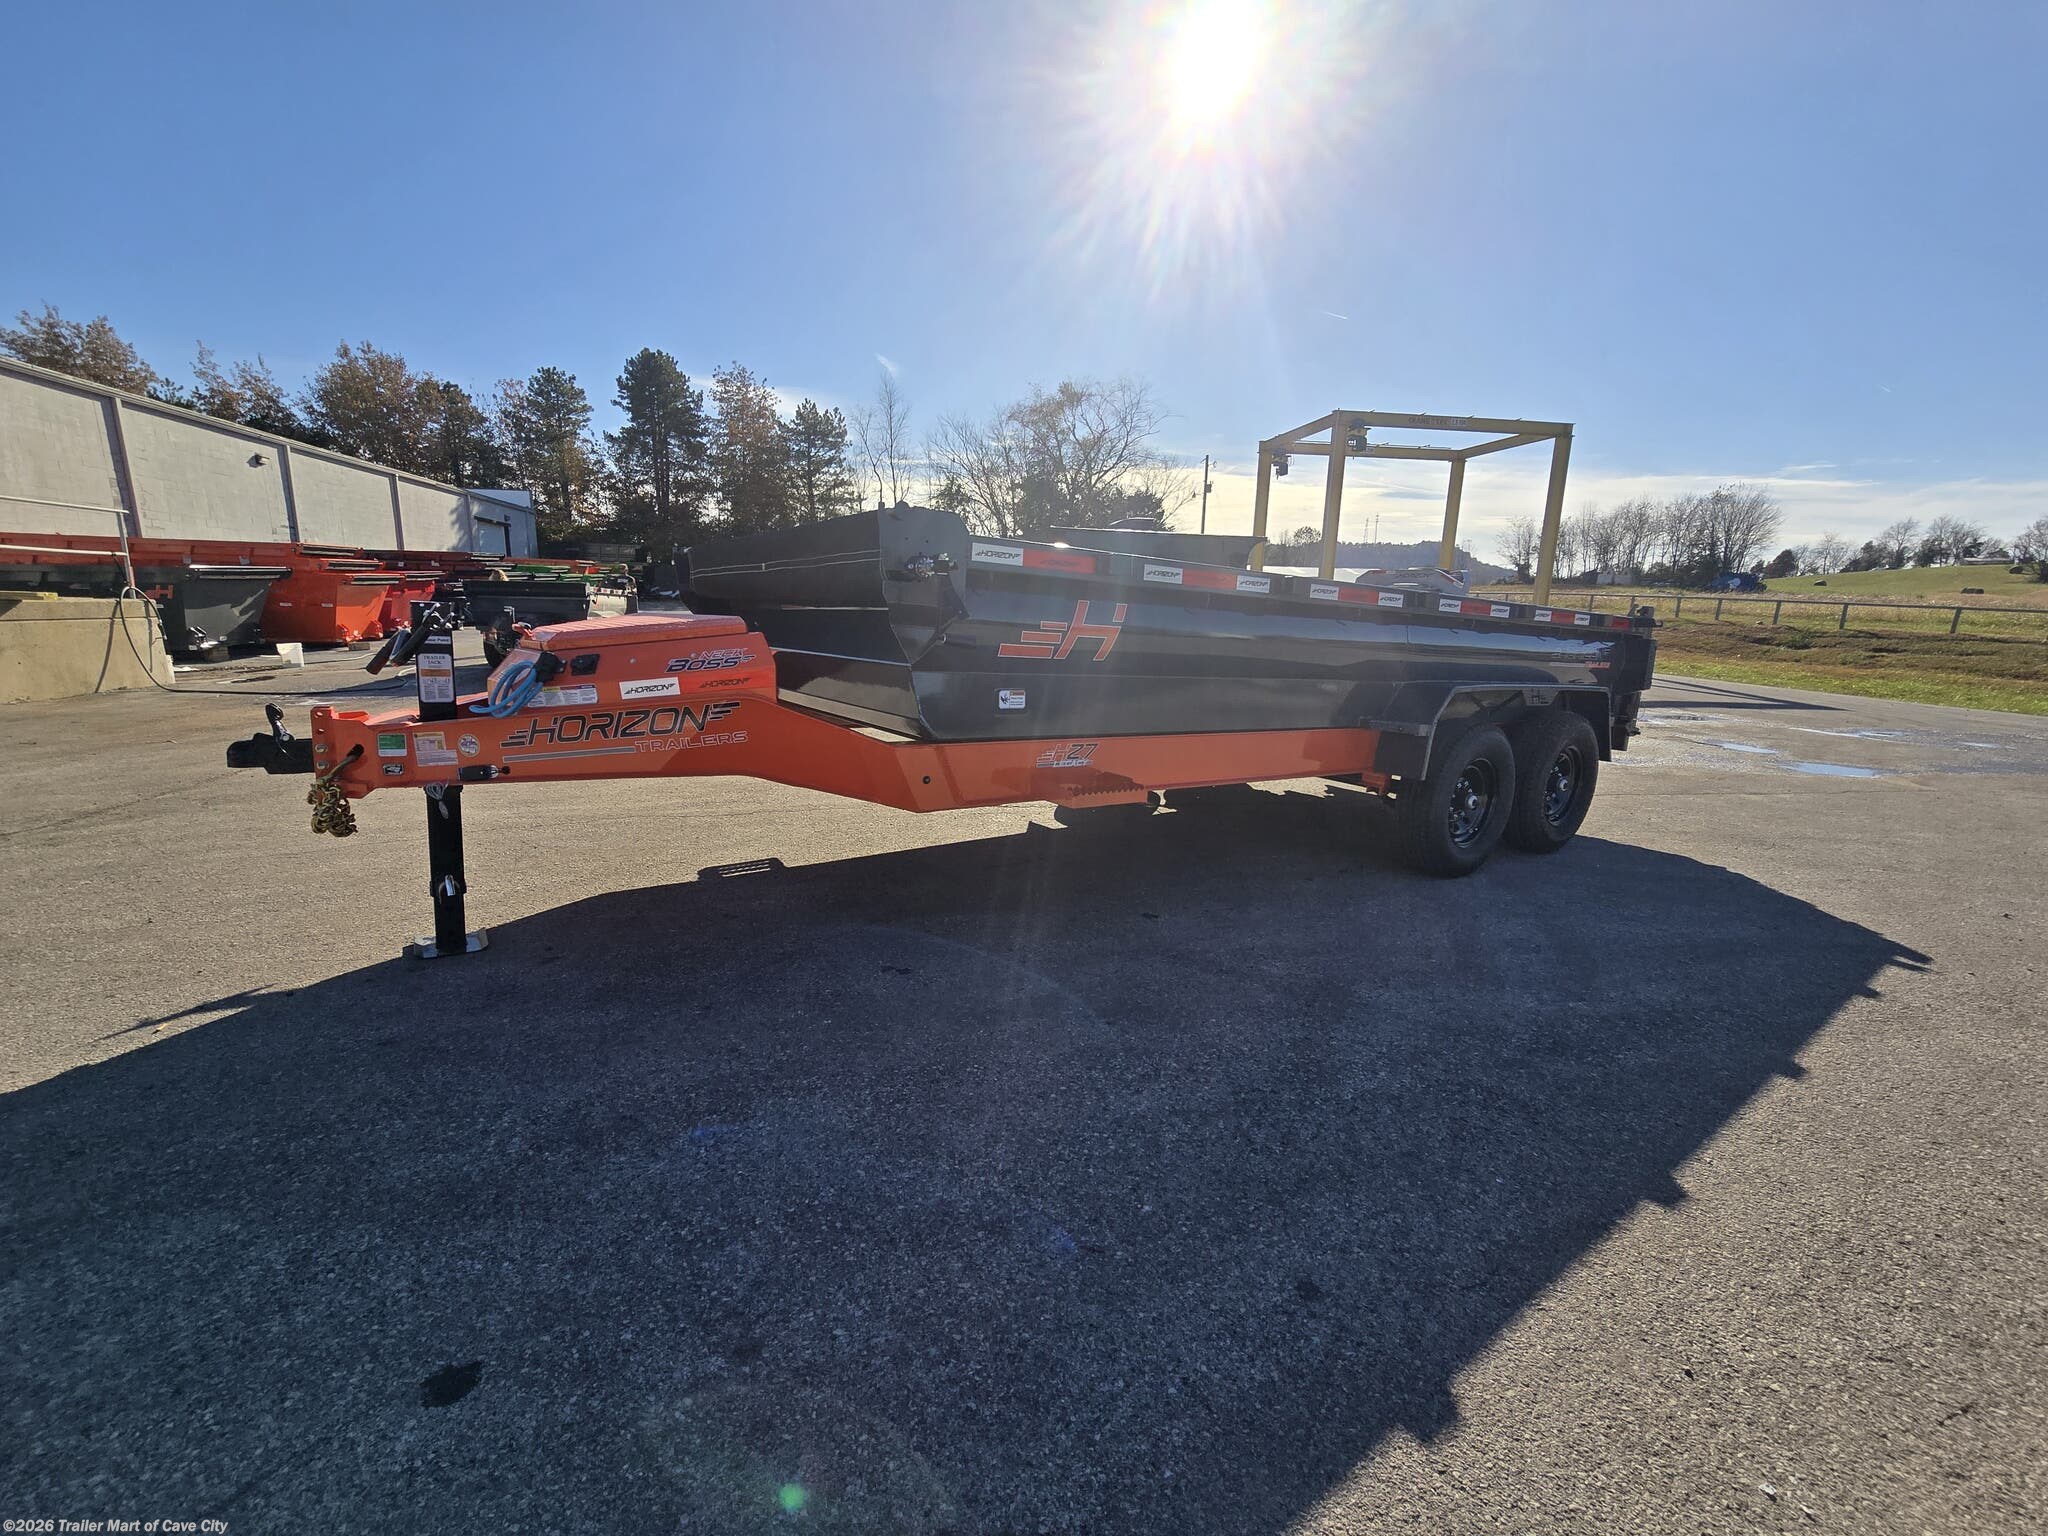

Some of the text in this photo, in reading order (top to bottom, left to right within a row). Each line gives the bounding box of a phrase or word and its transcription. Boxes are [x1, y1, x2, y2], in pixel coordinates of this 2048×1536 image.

[980, 549, 1016, 559] HORIZON
[700, 648, 748, 660] NECK
[664, 656, 748, 673] BOSS
[629, 684, 671, 695] HORIZON
[703, 679, 745, 689] HORIZON
[526, 703, 716, 747] HORIZON
[634, 730, 749, 753] TRAILERS
